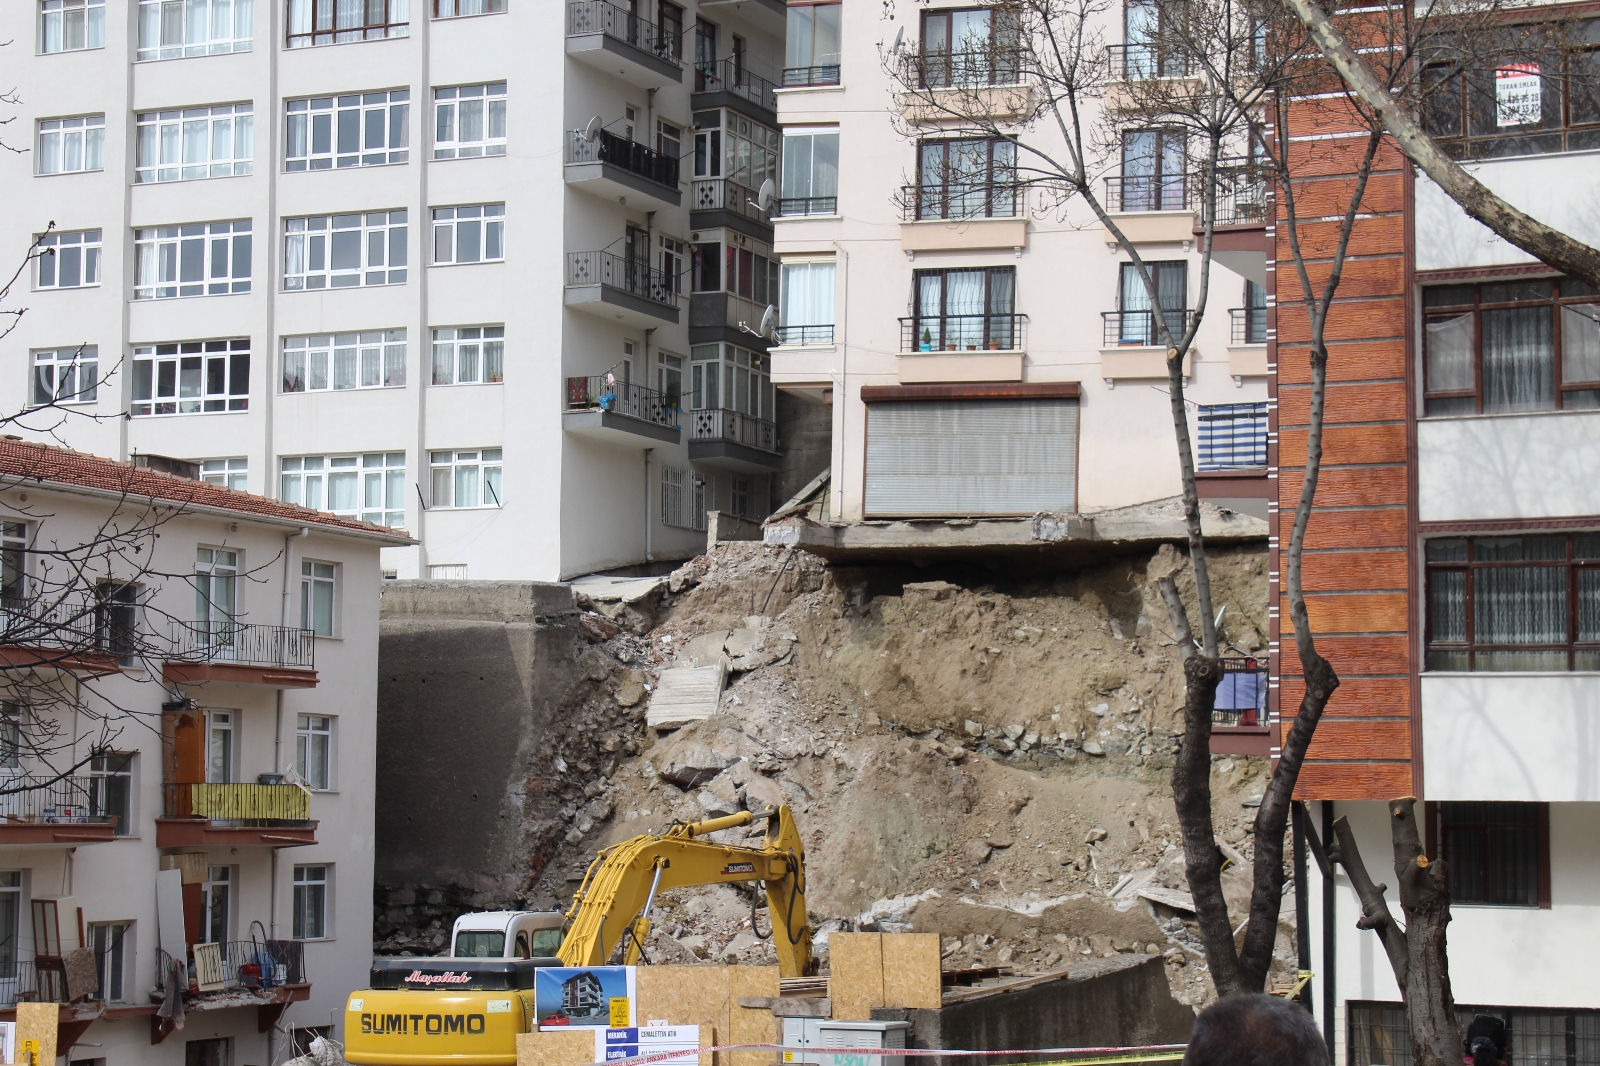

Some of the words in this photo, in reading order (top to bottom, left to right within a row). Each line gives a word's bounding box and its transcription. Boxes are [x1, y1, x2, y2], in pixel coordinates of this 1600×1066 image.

[1531, 93, 1539, 102] 28
[728, 865, 753, 873] SUMITOMO
[404, 970, 472, 985] Maşallah
[361, 1013, 485, 1035] SUMITOMO
